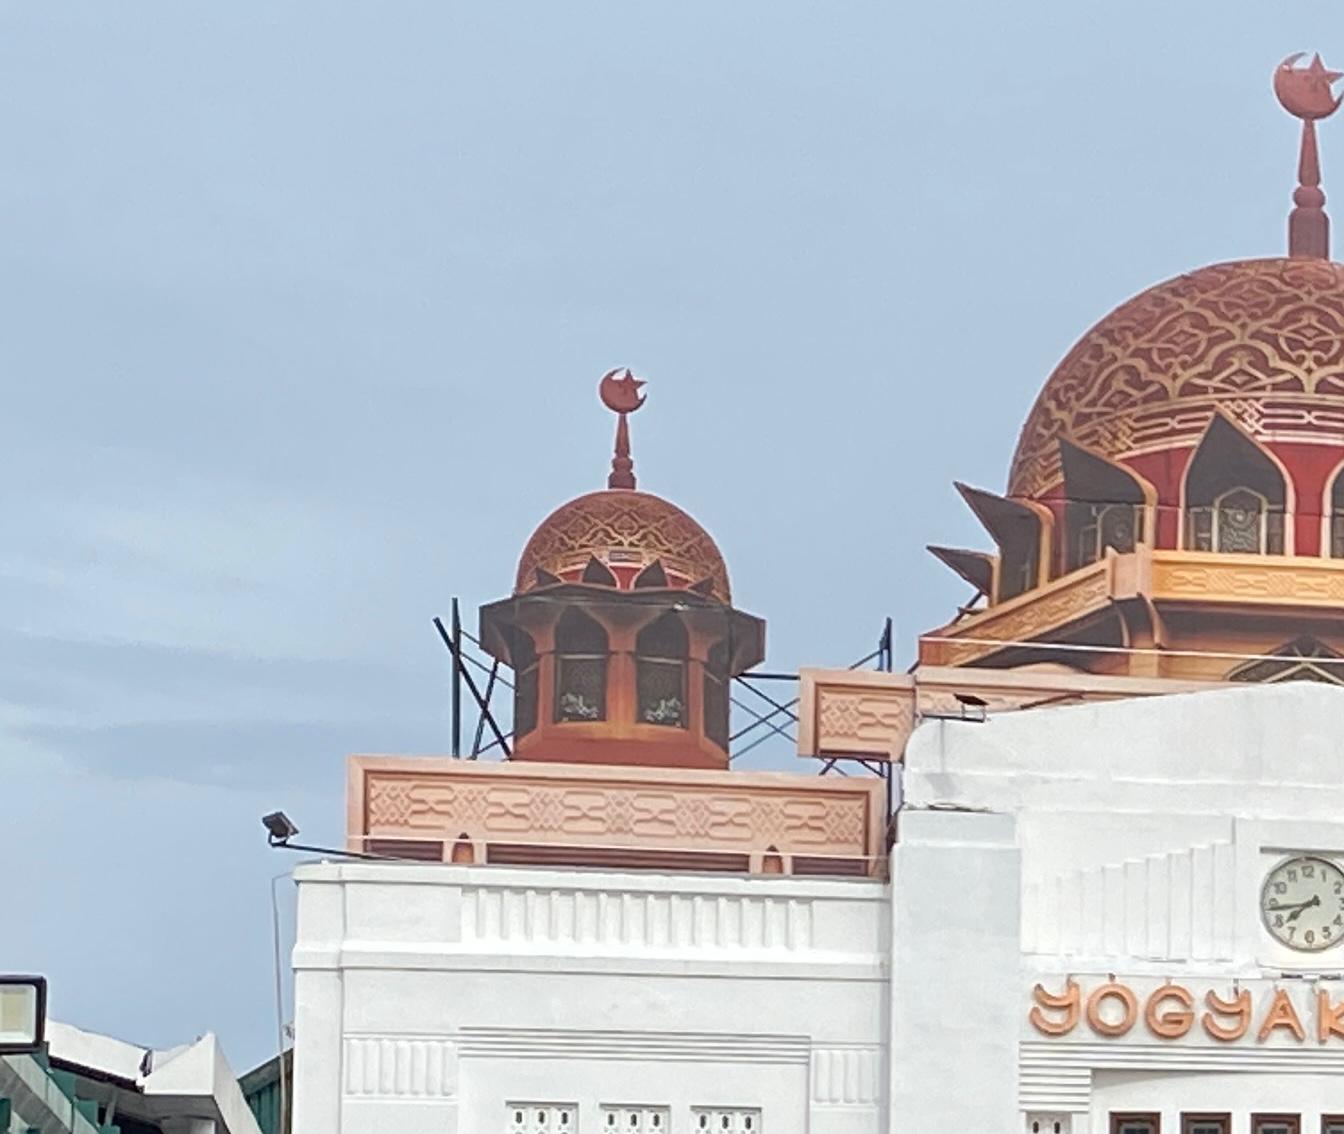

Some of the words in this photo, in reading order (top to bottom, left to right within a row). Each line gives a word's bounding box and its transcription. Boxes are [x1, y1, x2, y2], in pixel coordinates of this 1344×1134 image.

[1333, 881, 1343, 895] 2
[1286, 926, 1296, 940] 7
[1304, 929, 1315, 944] 6
[1321, 926, 1332, 940] 5
